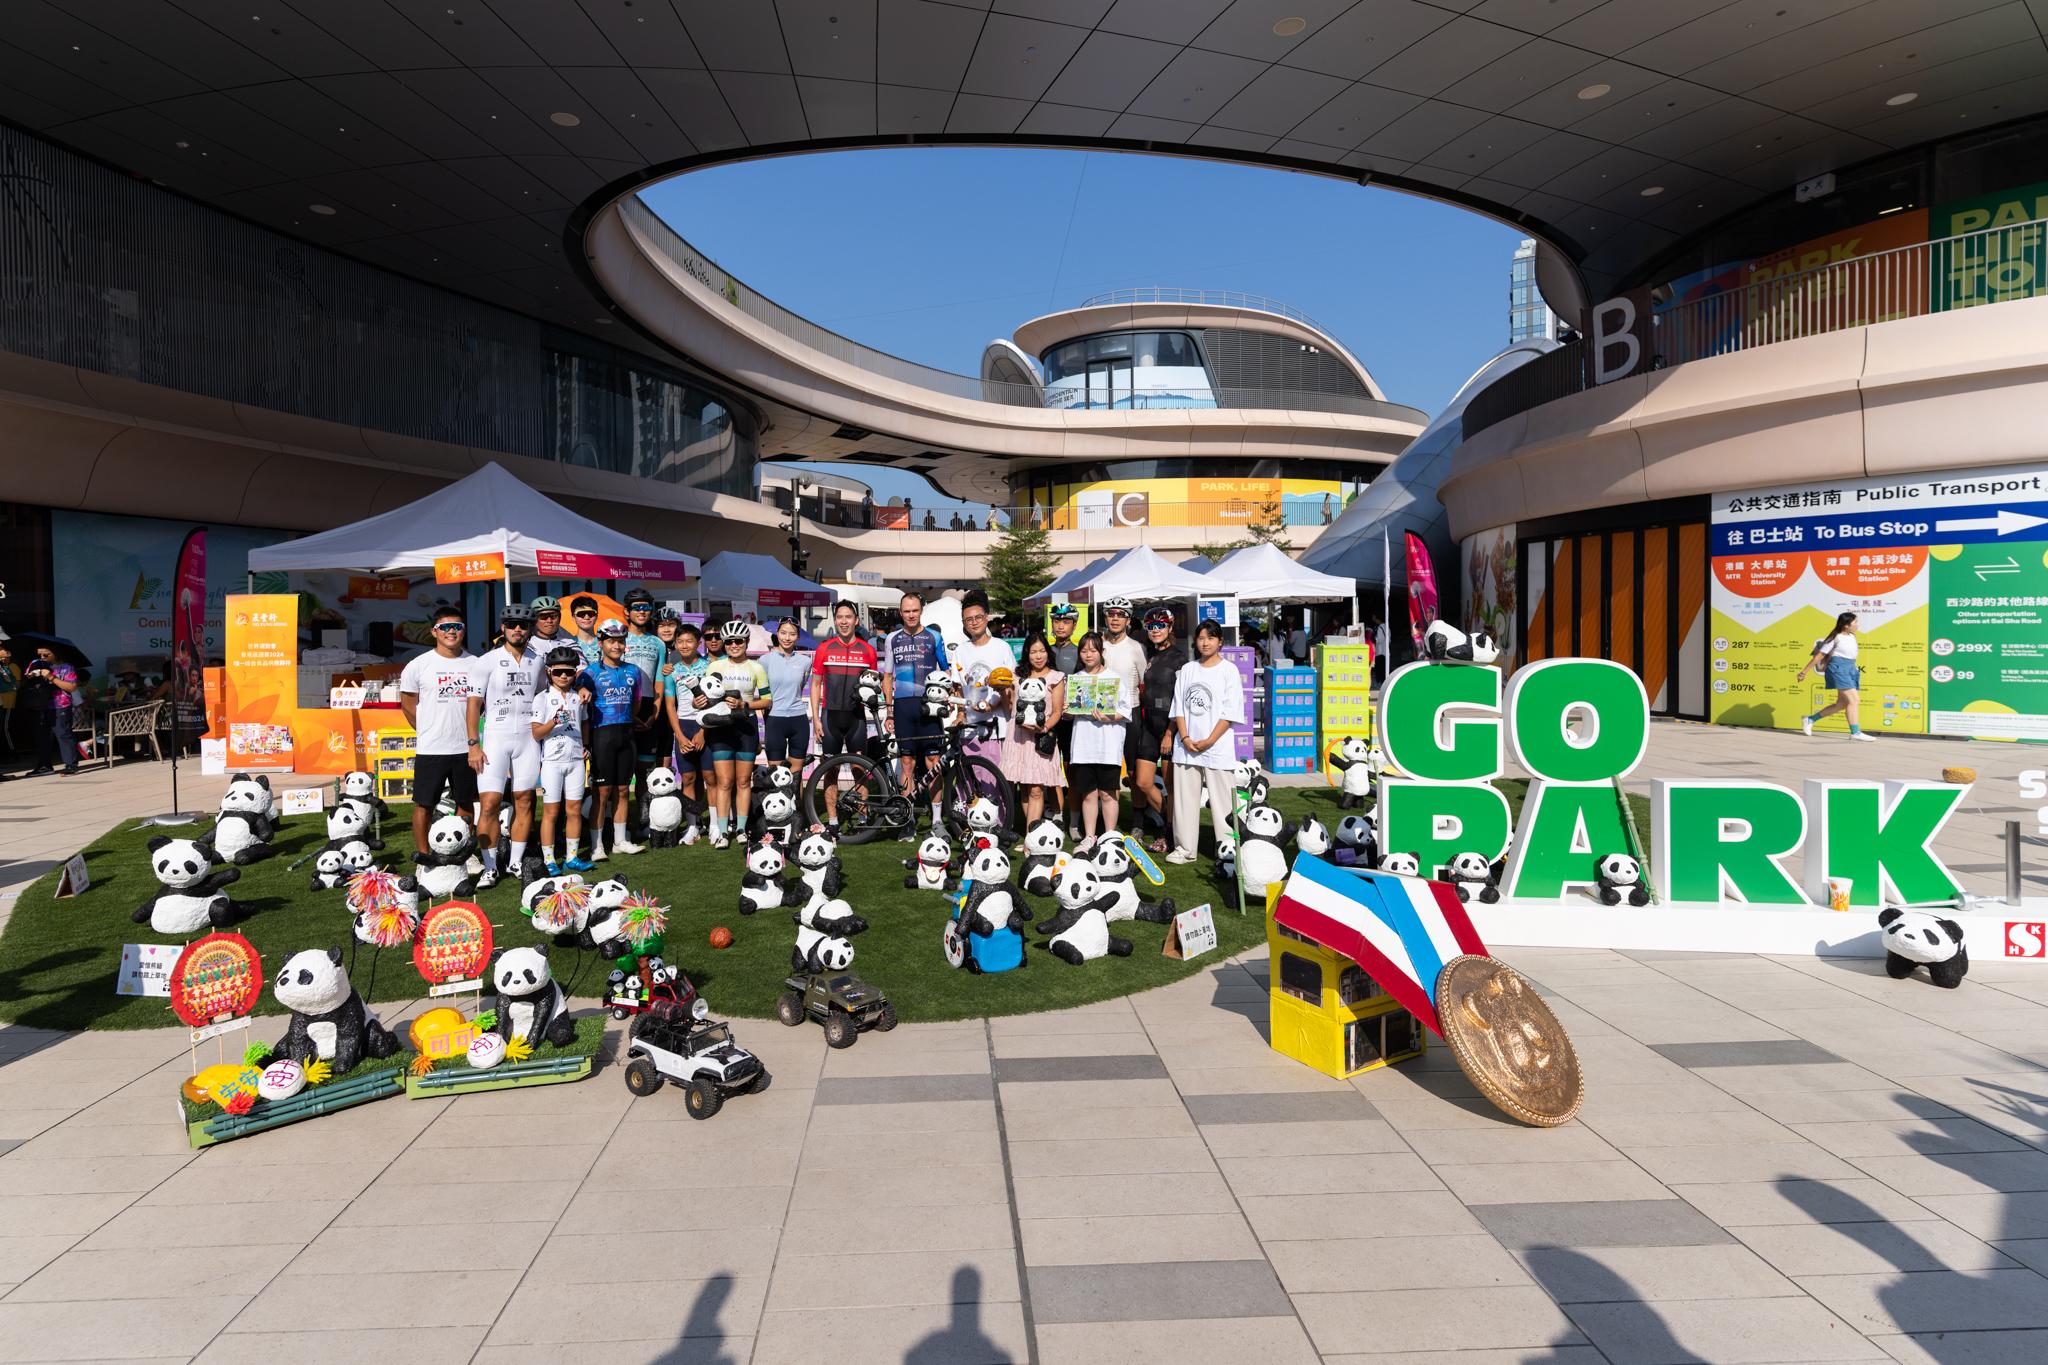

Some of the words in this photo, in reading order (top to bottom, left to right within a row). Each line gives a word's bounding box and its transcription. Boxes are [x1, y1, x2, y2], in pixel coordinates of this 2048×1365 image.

[1592, 297, 1641, 385] B
[1728, 489, 1842, 513] 公共交通指南
[1856, 485, 1920, 502] Public
[1928, 476, 2041, 496] Transport
[1116, 493, 1146, 527] C
[1727, 530, 1744, 546] 往
[1750, 525, 1804, 544] 巴士站
[1814, 526, 1835, 539] To
[1839, 524, 1876, 538] Bus
[1879, 521, 1929, 537] Stop
[1750, 559, 1788, 570] 大學站
[610, 568, 619, 577] Ng
[619, 569, 631, 578] Fung
[645, 570, 662, 578] Limited
[1750, 572, 1787, 580] University
[1826, 569, 1847, 577] MTR
[1858, 575, 1889, 583] Station
[893, 645, 916, 654] ISRAEL
[1731, 641, 1750, 649] 287
[1957, 643, 1993, 652] 299X
[1731, 662, 1750, 670] 582
[1957, 671, 1975, 680] 99
[1730, 684, 1755, 692] 807K
[1381, 657, 1650, 782] GO
[1381, 778, 1976, 908] PARK
